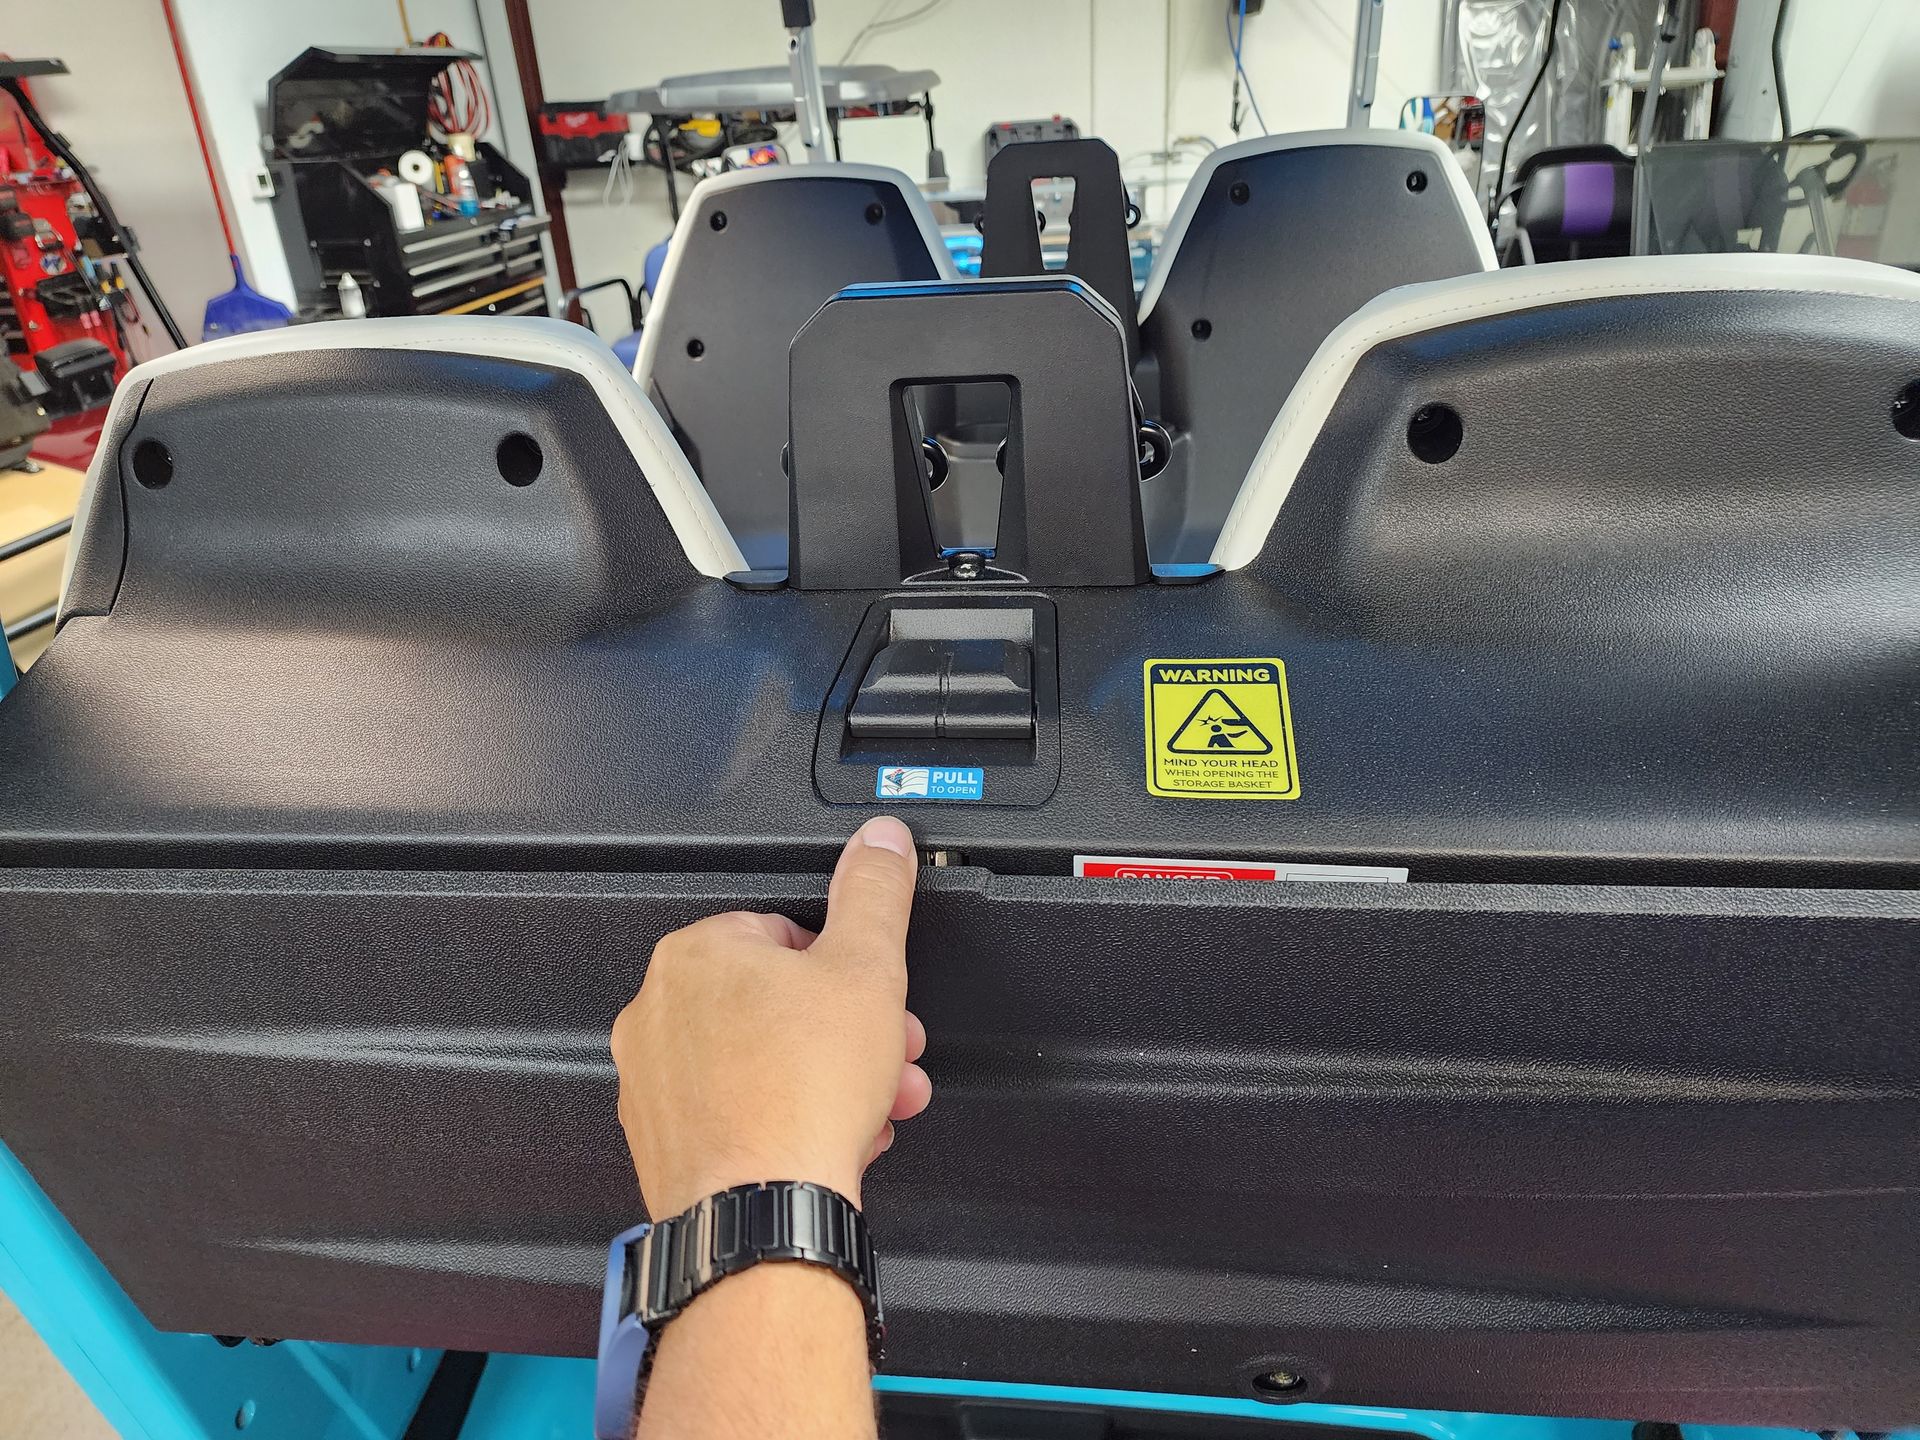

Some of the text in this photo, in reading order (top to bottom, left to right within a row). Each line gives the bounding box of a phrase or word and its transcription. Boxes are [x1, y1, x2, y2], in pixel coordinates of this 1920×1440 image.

[1159, 668, 1270, 682] WARNING
[1163, 758, 1279, 768] MIND YOUR HEAD
[932, 771, 978, 784] PULL
[1165, 769, 1279, 778] WHEN OPENING THE
[1173, 779, 1273, 789] STORAGE BASKET
[930, 785, 976, 794] TO OPEN
